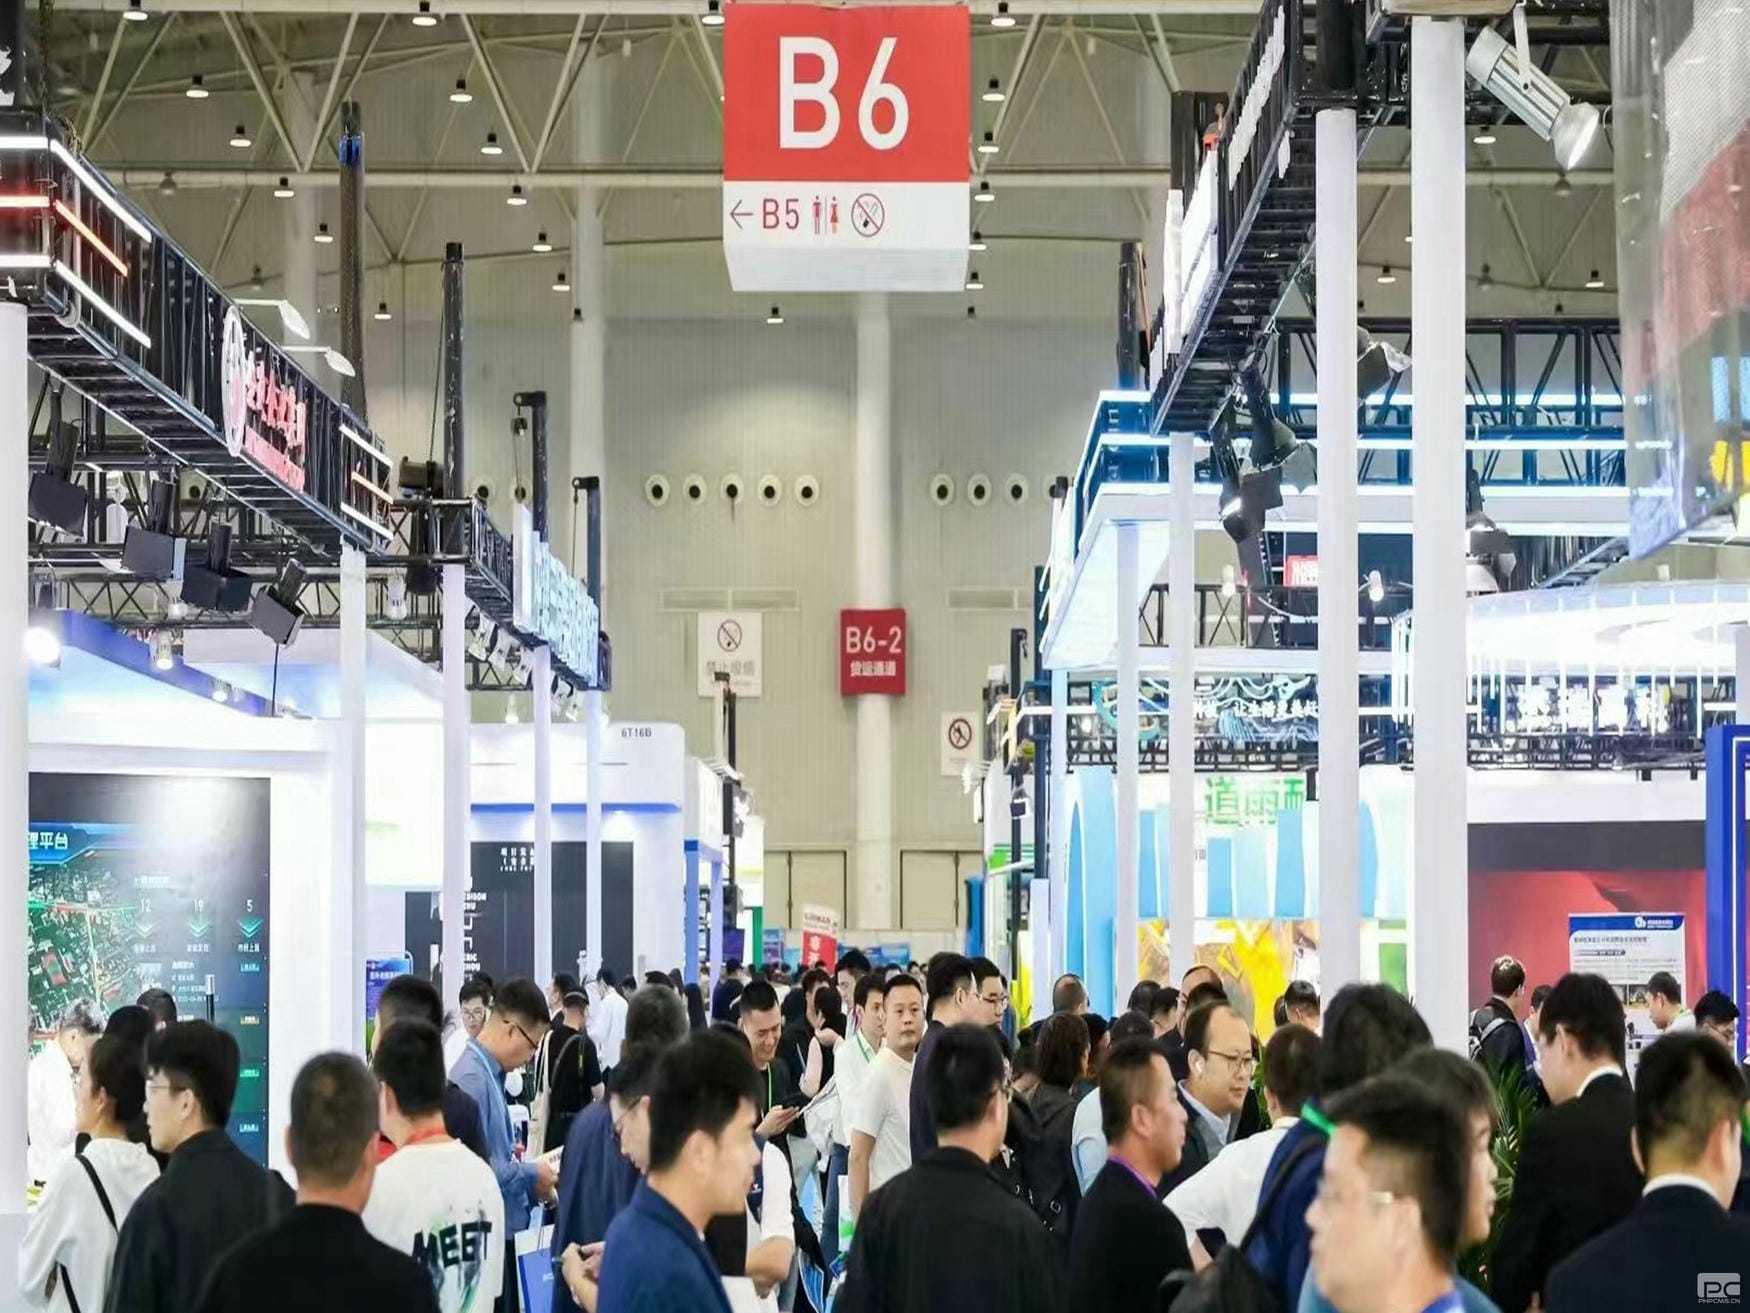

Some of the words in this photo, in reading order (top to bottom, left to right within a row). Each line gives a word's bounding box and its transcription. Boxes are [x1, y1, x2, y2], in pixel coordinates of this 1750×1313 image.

[779, 36, 910, 150] B6
[762, 199, 800, 229] B5
[846, 625, 902, 653] B6-2
[246, 899, 253, 912] 5
[412, 1221, 492, 1268] MEET
